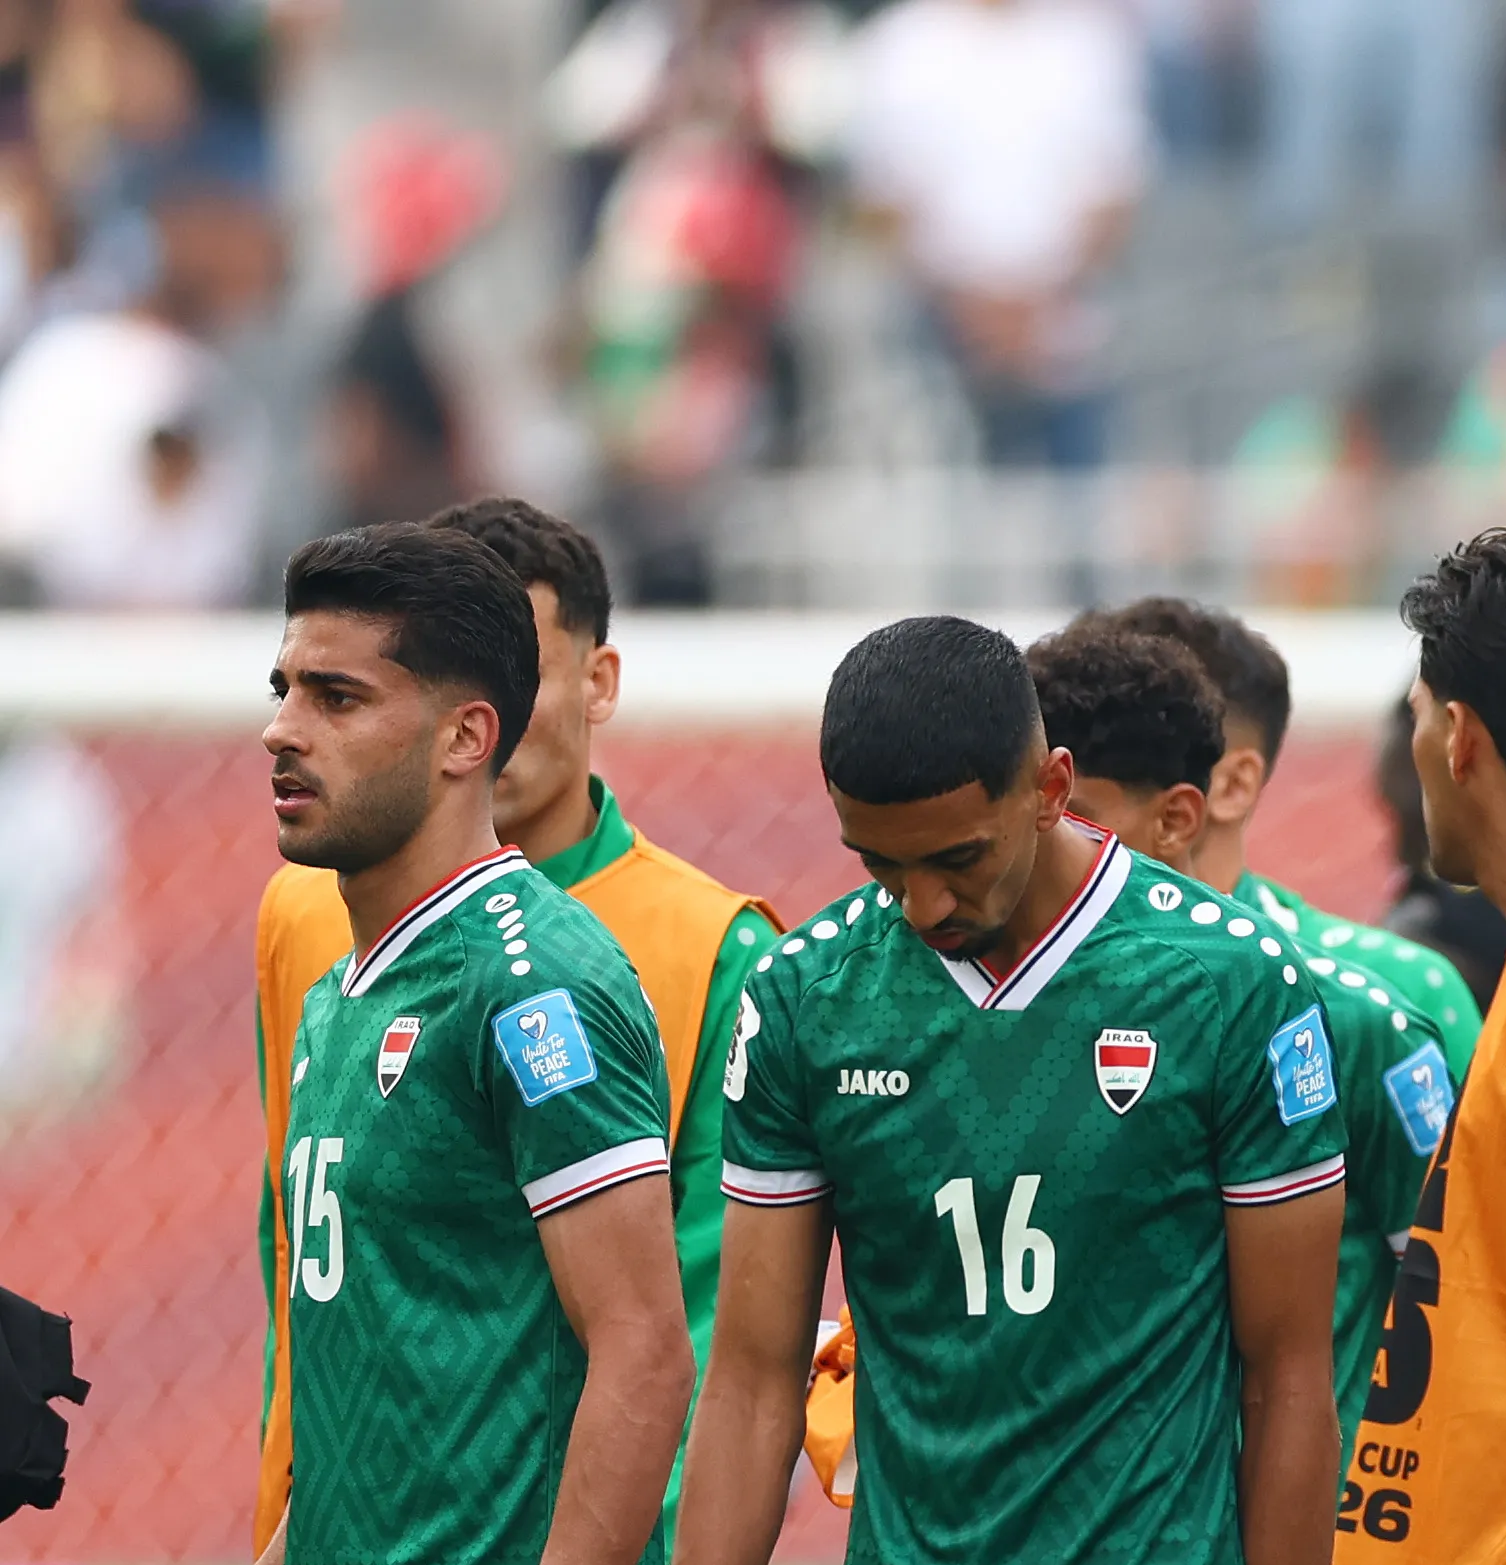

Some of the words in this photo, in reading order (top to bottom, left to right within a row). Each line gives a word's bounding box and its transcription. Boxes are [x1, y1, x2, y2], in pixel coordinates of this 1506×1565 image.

[394, 1020, 416, 1030] IRAQ
[1105, 1033, 1145, 1043] IRAQ
[521, 1041, 550, 1064] Unite
[548, 1032, 566, 1049] For
[530, 1050, 571, 1080] PEACE
[543, 1072, 567, 1087] FIFA
[837, 1068, 910, 1097] JAKO
[1295, 1072, 1327, 1098] PEACE
[1304, 1093, 1325, 1106] FIFA
[286, 1136, 344, 1302] 15
[934, 1174, 1056, 1316] 16
[1358, 1441, 1420, 1481] CUP
[1336, 1479, 1414, 1544] 26
